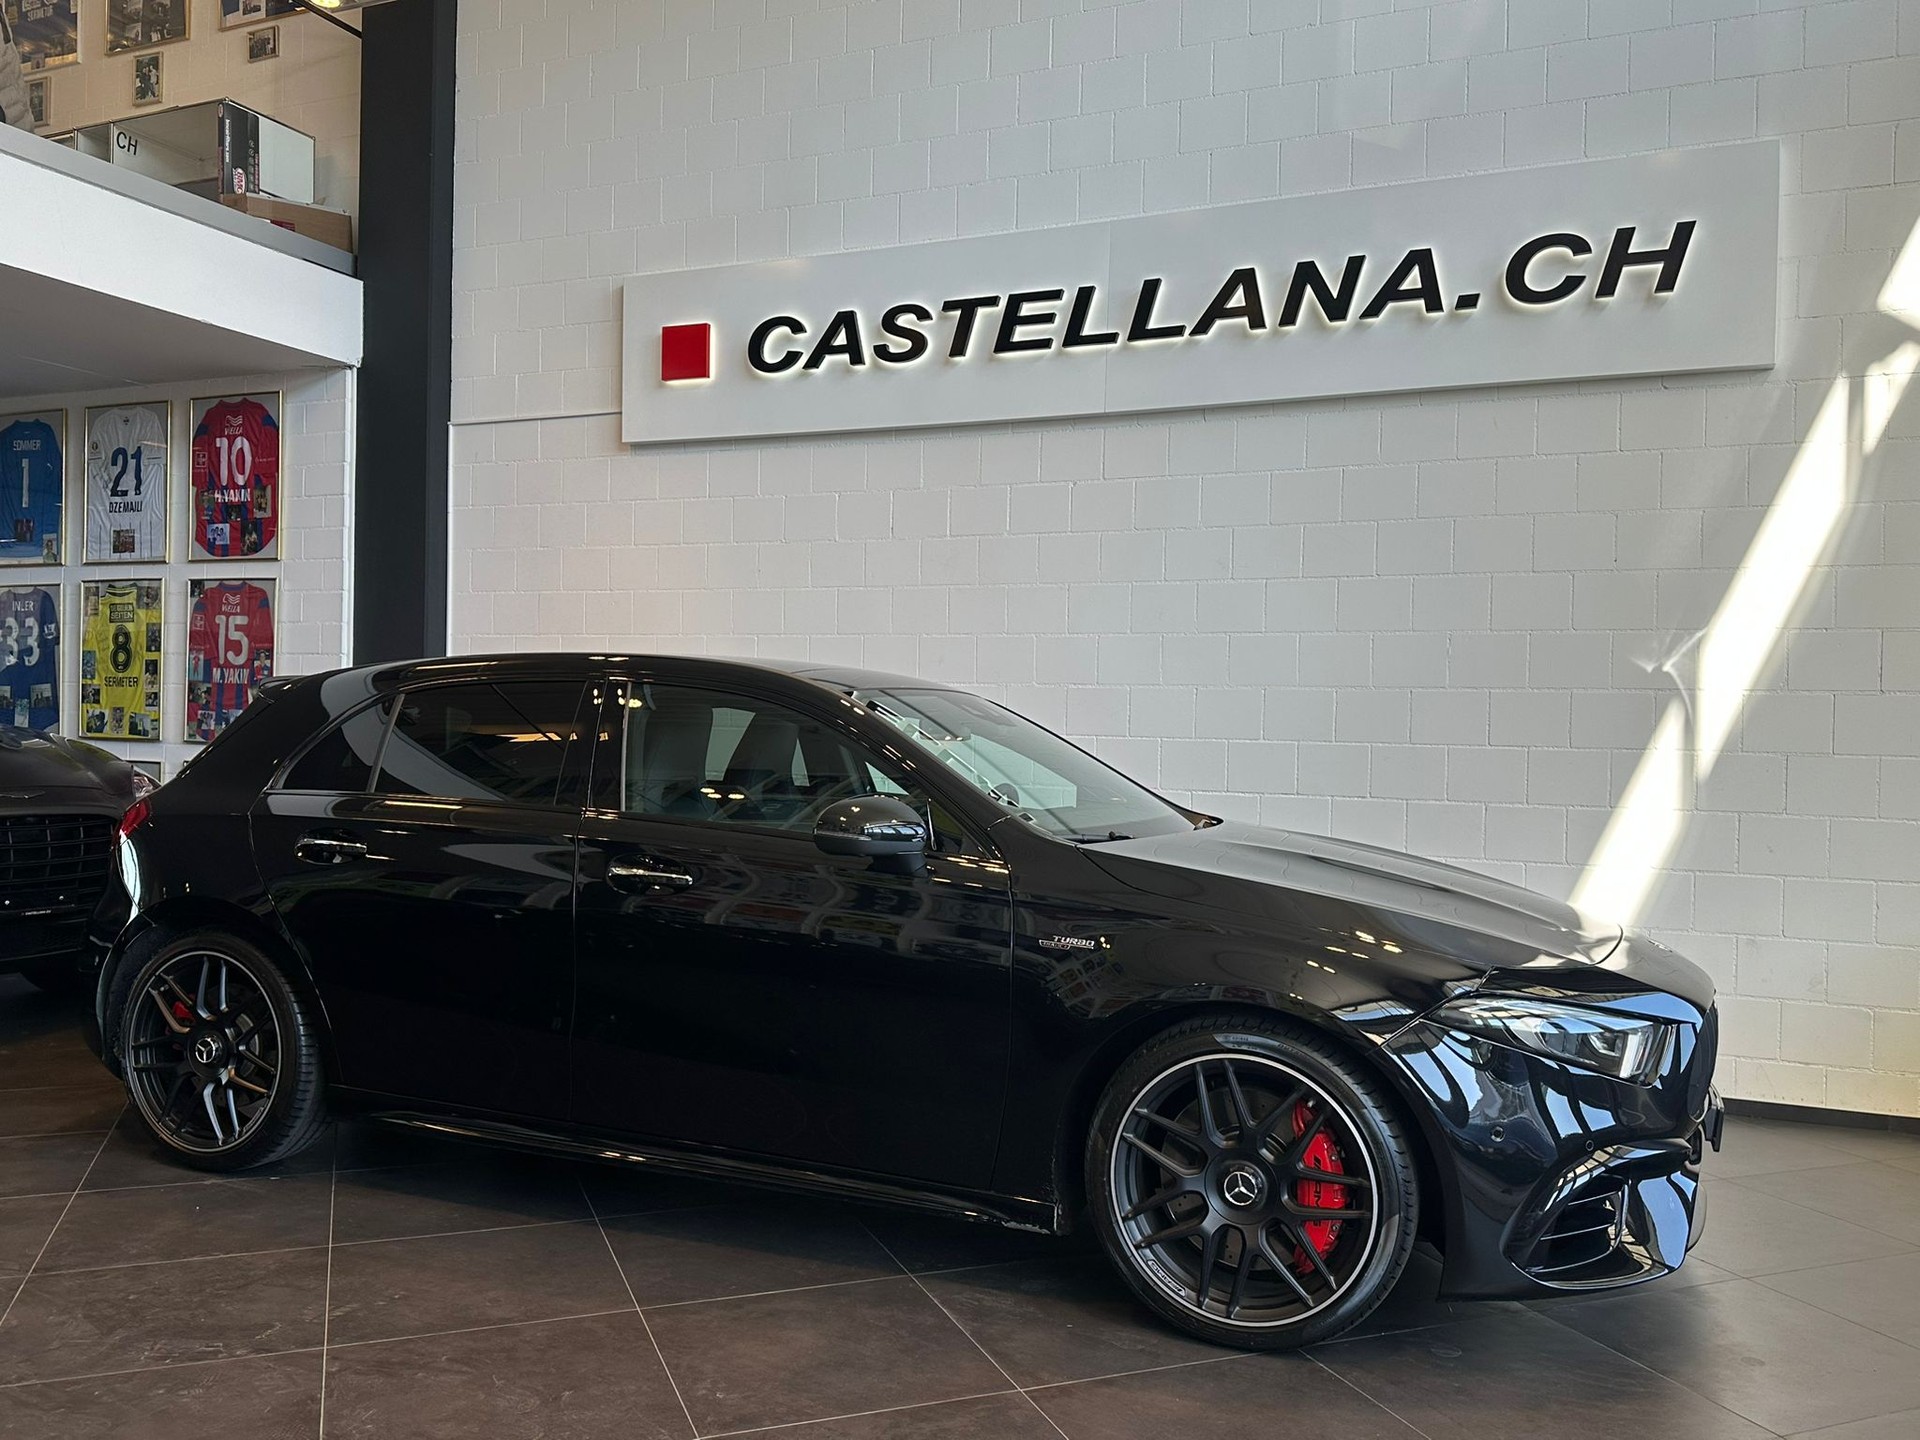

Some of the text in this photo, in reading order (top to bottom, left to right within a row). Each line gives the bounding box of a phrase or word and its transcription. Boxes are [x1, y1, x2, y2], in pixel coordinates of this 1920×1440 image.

[116, 131, 138, 156] CH
[747, 219, 1698, 374] CASTELLANA.CH
[13, 439, 41, 451] SOMMER
[215, 436, 252, 486] 10
[21, 458, 30, 508] 1
[110, 446, 143, 497] 21
[12, 600, 34, 611] INLER
[4, 617, 40, 667] 33
[110, 624, 133, 673] 8
[215, 615, 249, 665] 15
[104, 676, 139, 688] SERMETER
[212, 667, 250, 684] M.YAKIN
[1053, 935, 1095, 947] TURBO
